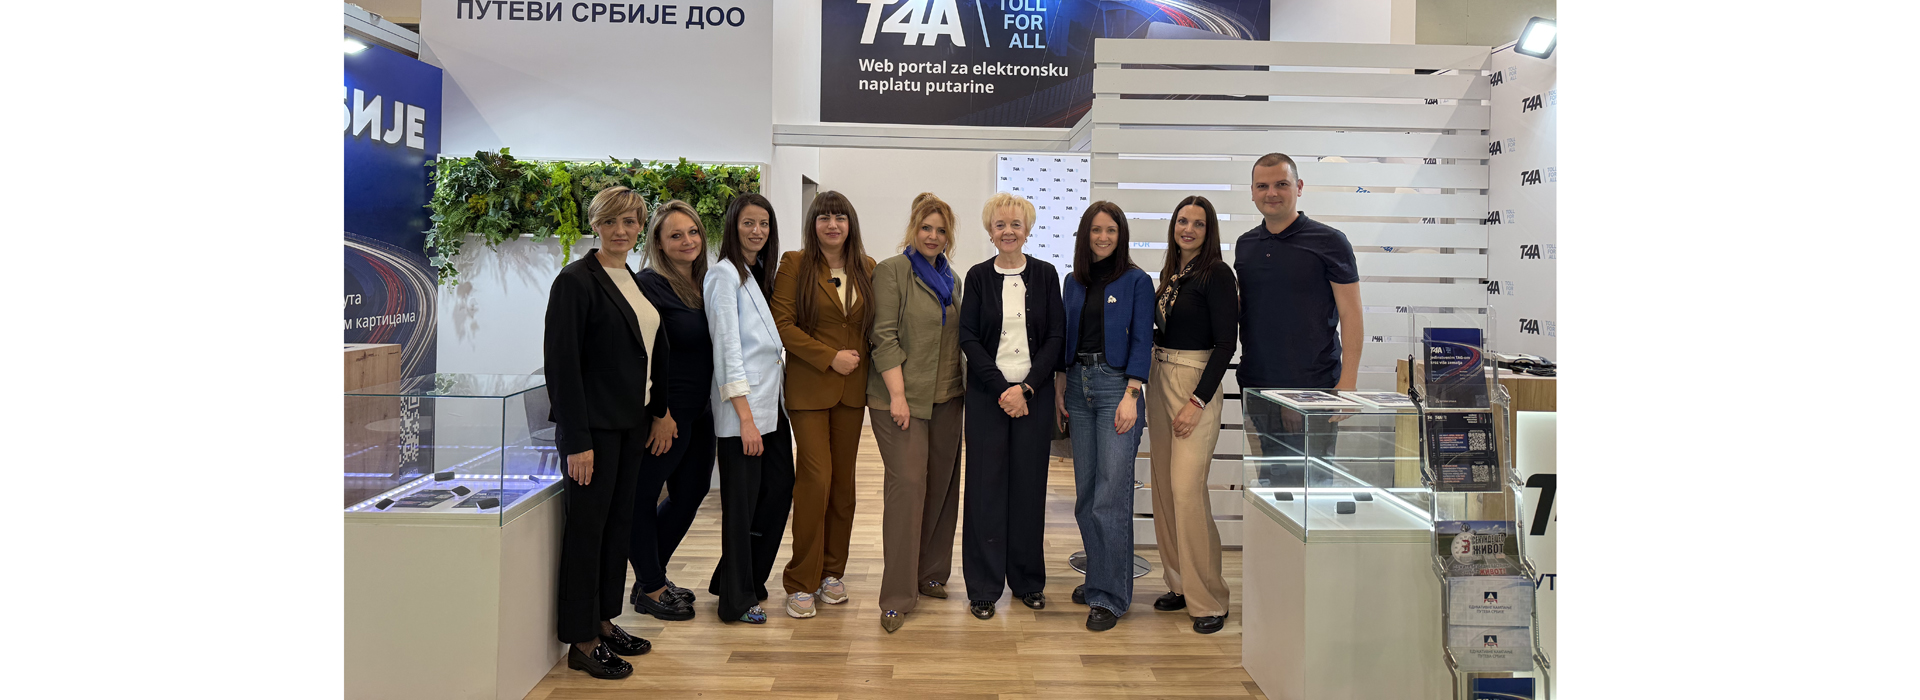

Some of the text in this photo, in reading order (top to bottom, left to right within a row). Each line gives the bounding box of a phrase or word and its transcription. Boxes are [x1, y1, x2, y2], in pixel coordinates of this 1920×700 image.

[457, 0, 746, 29] ПУТЕВИ СРБИЈЕ ДОО
[1004, 14, 1043, 30] FOR
[857, 0, 966, 47] T4A
[1009, 33, 1046, 49] ALL
[859, 59, 1069, 77] Web portal za elektronsku
[859, 77, 995, 95] naplatu putarine
[1488, 71, 1503, 87] 4A
[1522, 94, 1543, 113] T4A
[1489, 141, 1502, 156] 4A
[1521, 169, 1542, 186] T4A
[1520, 244, 1541, 260] T4A
[356, 312, 416, 331] картицама
[1519, 318, 1540, 335] T4A
[1473, 543, 1504, 555] ЖИВОТ
